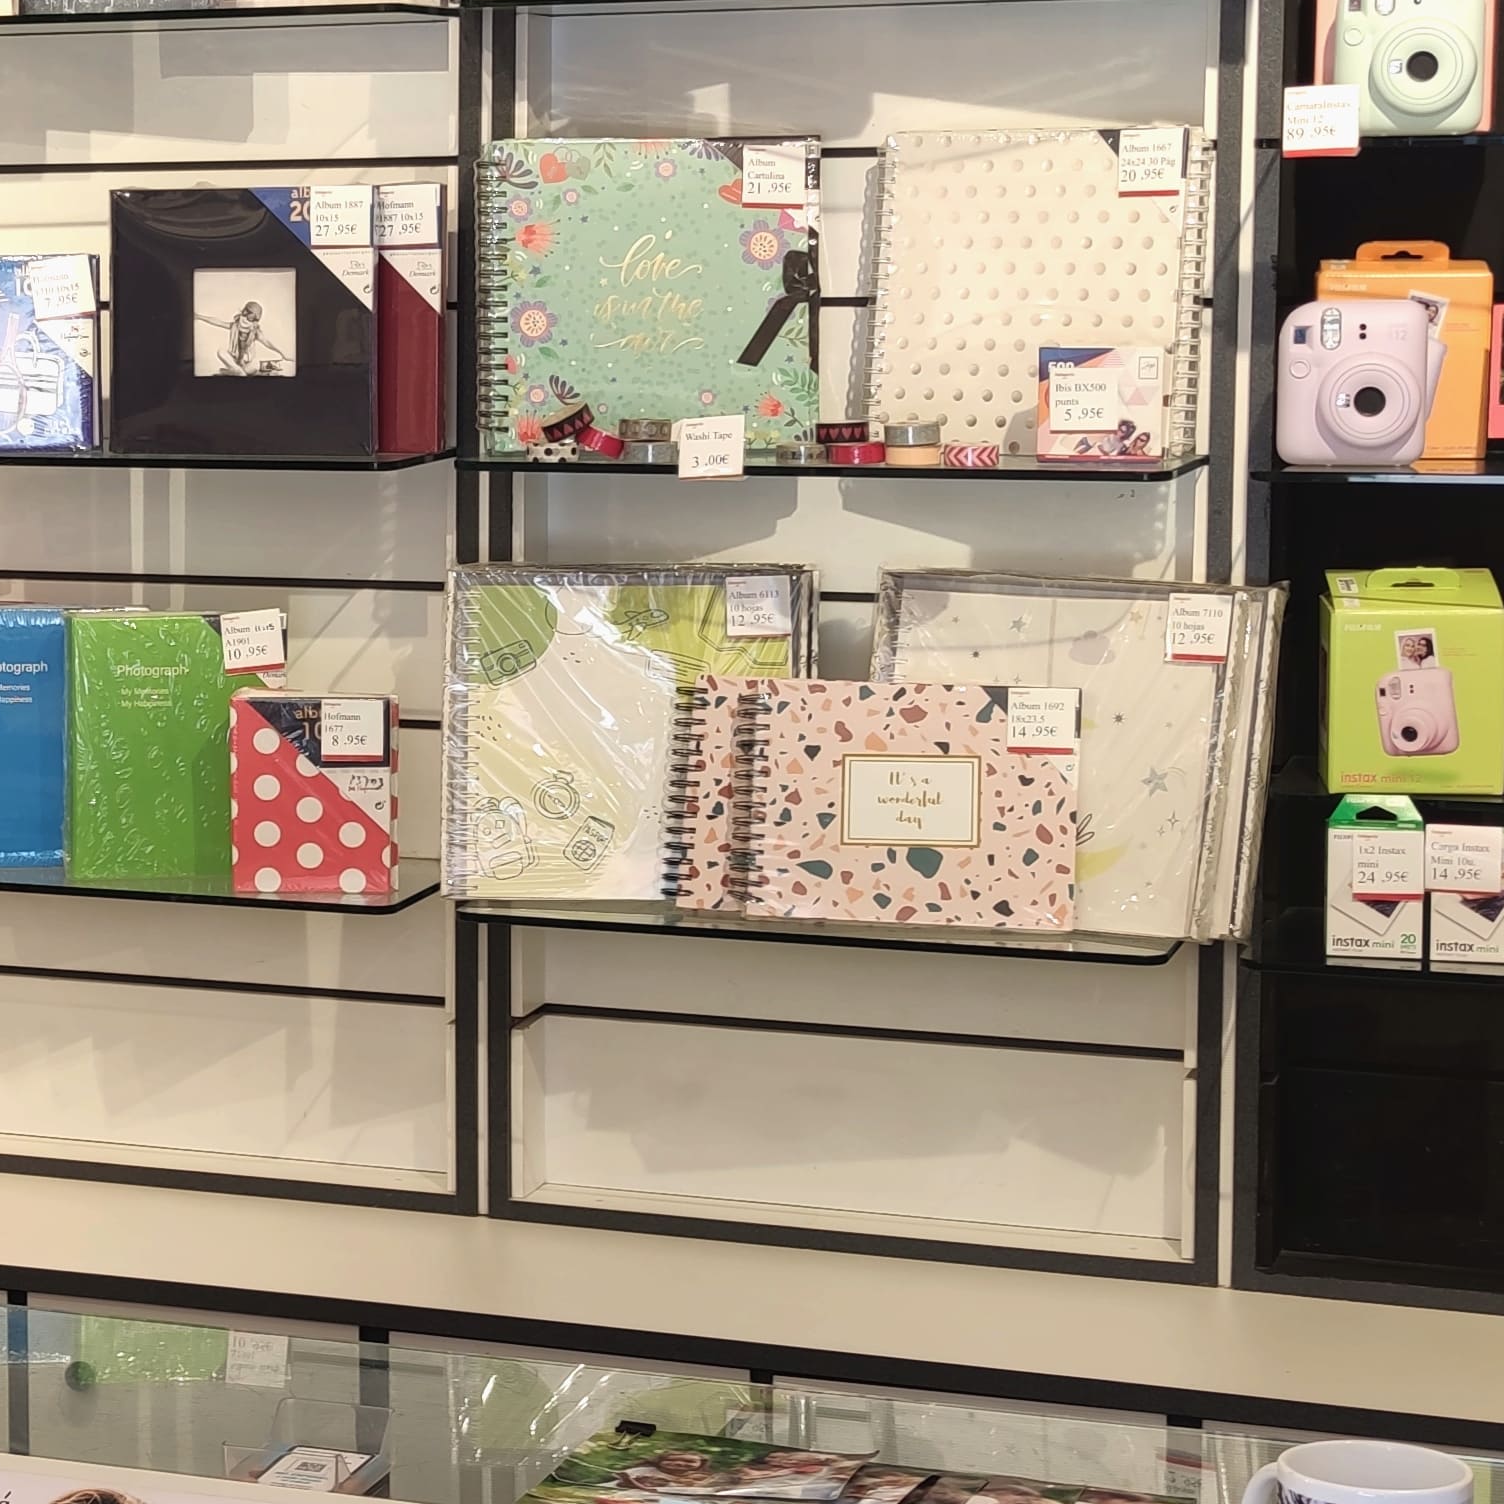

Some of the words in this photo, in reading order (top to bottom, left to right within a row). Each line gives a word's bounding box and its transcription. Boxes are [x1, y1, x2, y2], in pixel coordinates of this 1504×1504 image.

[685, 430, 708, 441] Washi
[712, 430, 733, 442] Tape
[1332, 934, 1368, 950] instax
[1371, 938, 1394, 950] mini
